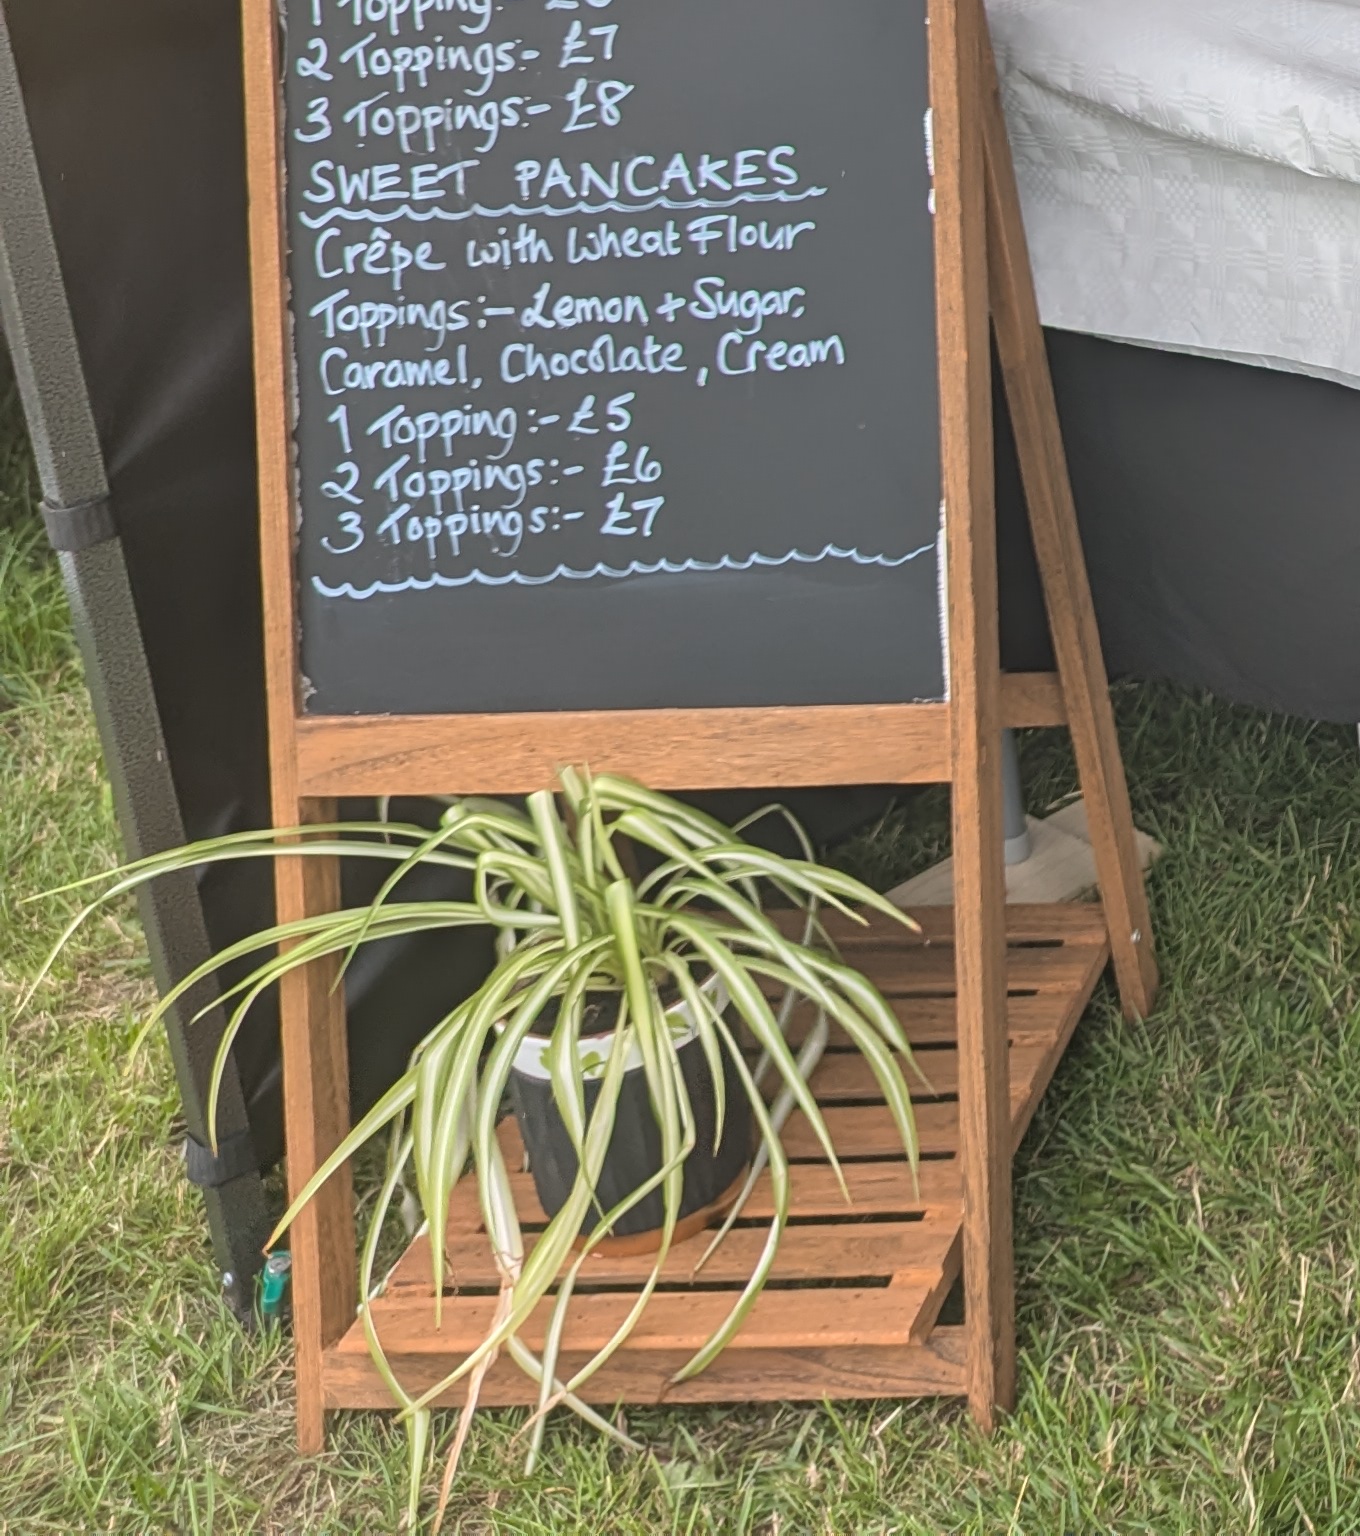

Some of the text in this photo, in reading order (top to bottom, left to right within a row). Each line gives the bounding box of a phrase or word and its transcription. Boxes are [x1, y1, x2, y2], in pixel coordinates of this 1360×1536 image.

[296, 37, 334, 81] 2
[558, 20, 620, 69] £7
[294, 97, 333, 143] 3
[561, 78, 635, 134] £8
[303, 146, 802, 205] SWEET PANCAKES
[315, 227, 447, 291] Crêpe
[466, 223, 553, 269] with
[687, 214, 816, 256] Flour
[520, 281, 649, 328] Lemon
[656, 292, 687, 322] +
[715, 331, 846, 376] Cream
[328, 404, 353, 454] 1
[567, 394, 636, 435] £5
[320, 461, 364, 505] 2
[600, 440, 662, 487] £6
[321, 511, 364, 555] 3
[600, 492, 664, 537] £7
